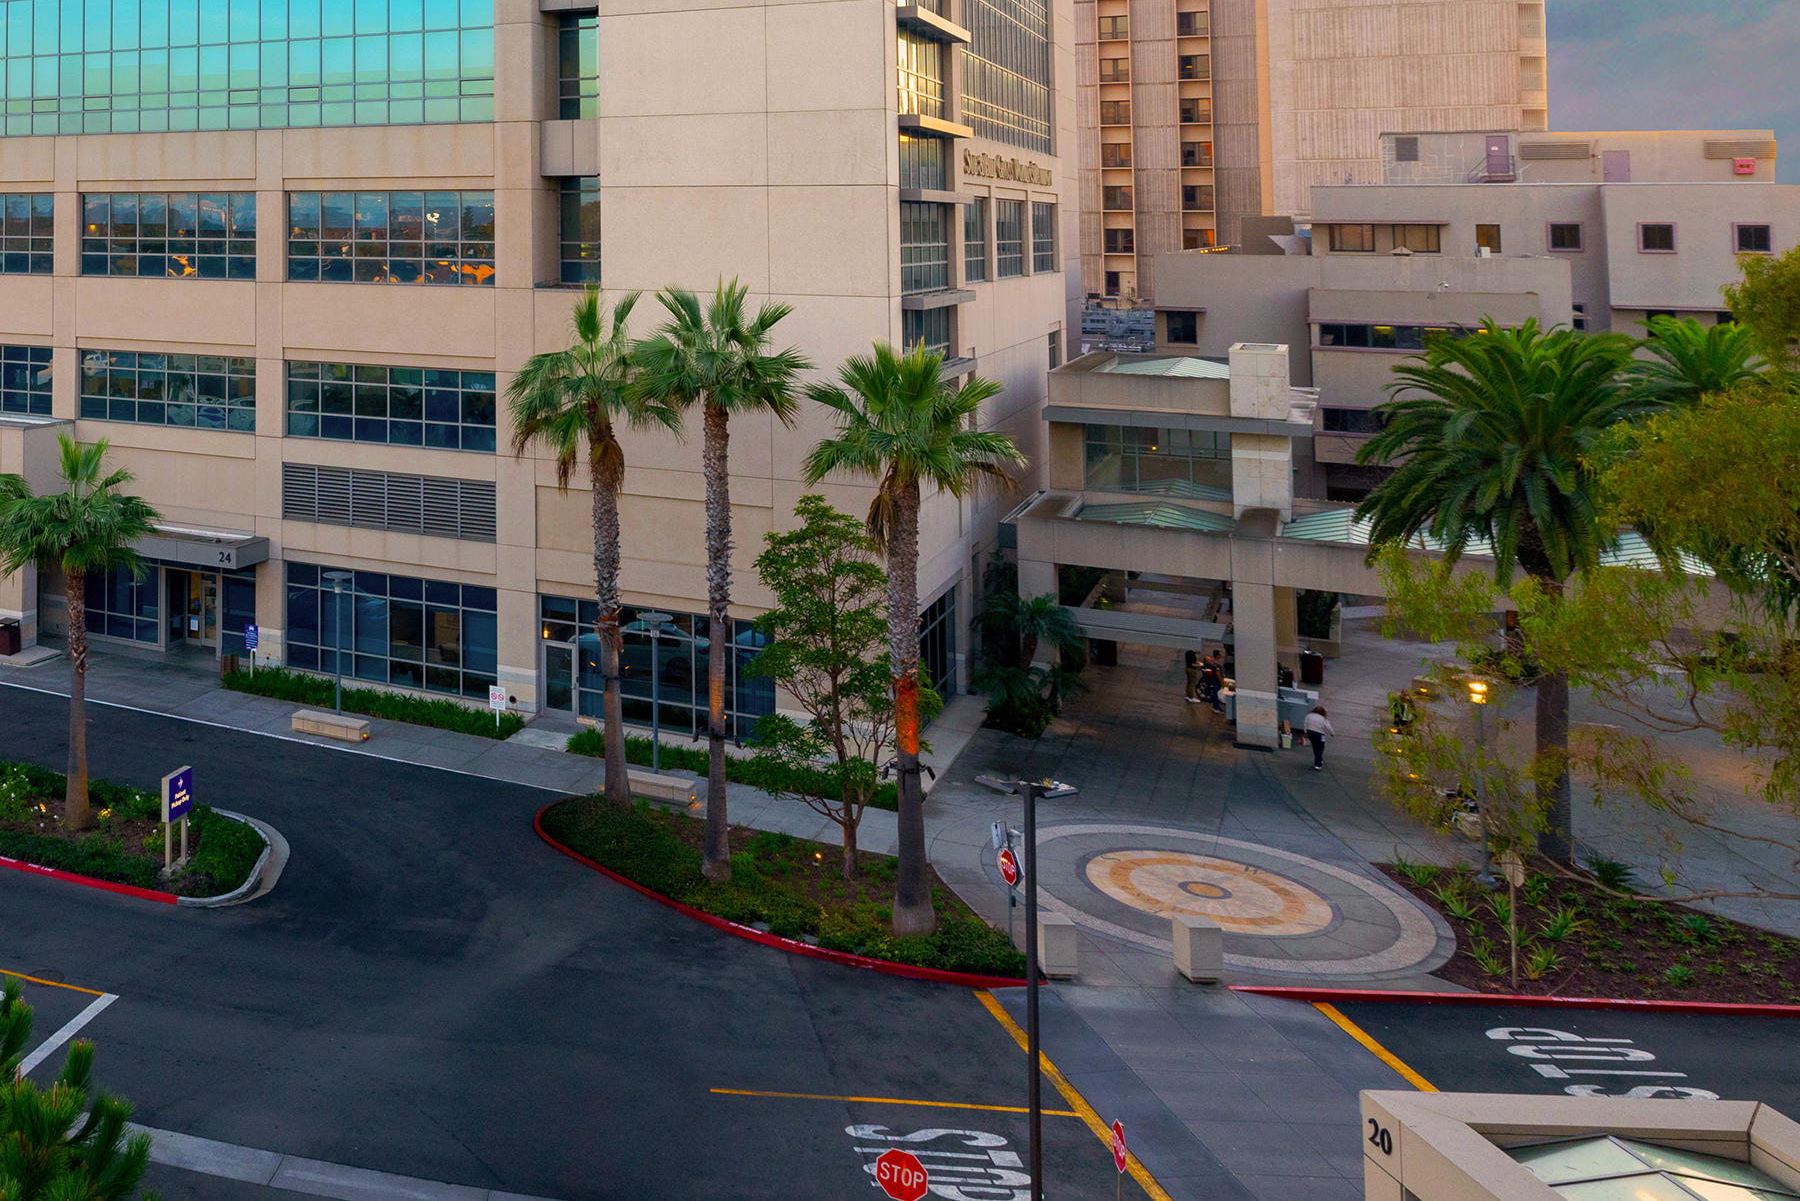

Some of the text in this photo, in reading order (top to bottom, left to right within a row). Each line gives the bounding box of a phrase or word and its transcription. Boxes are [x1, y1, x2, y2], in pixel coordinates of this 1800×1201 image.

[218, 551, 232, 564] 24
[1001, 860, 1016, 877] STOP
[1485, 1027, 1721, 1100] STOP
[1368, 1117, 1393, 1156] 20
[880, 1161, 925, 1189] STOP
